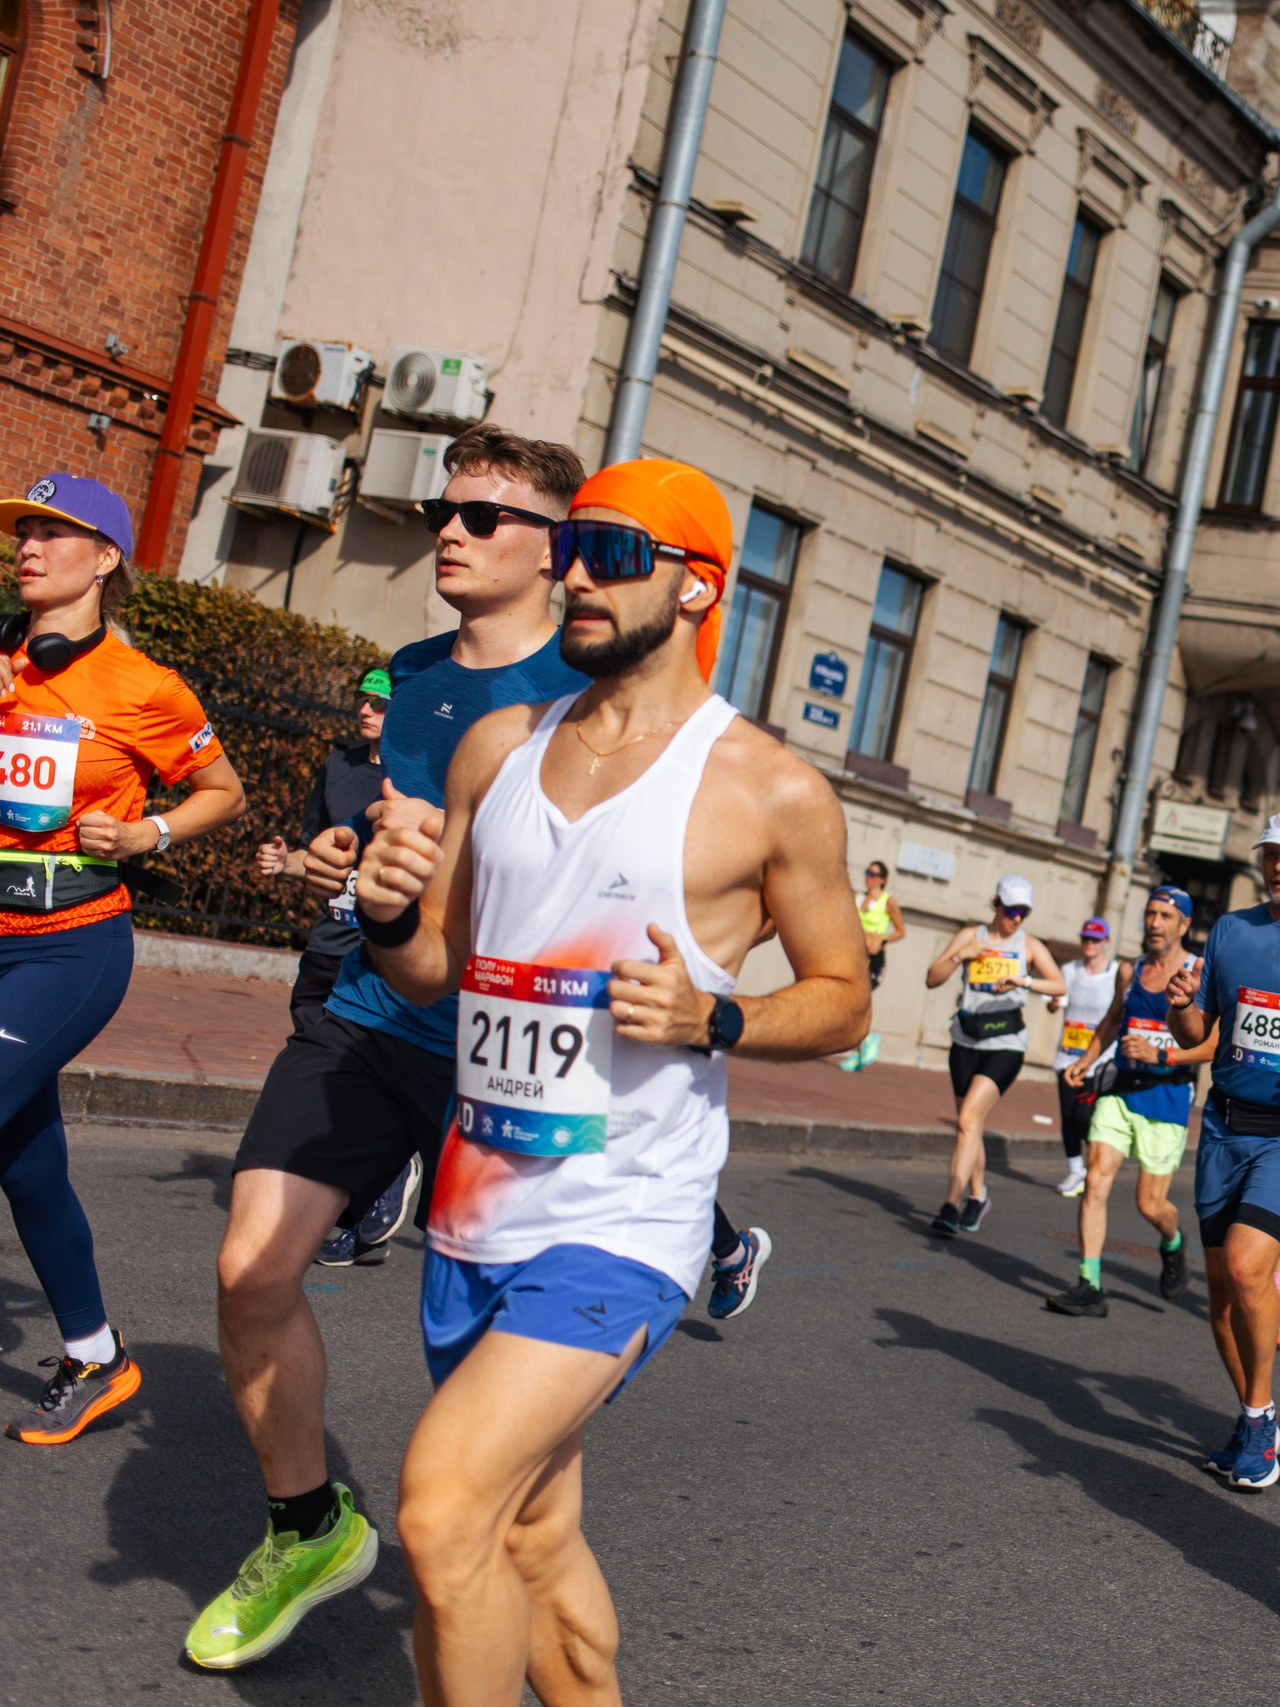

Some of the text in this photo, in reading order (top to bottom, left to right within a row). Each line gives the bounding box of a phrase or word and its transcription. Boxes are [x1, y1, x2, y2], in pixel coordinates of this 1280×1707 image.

[22, 720, 63, 734] 21,1 КМ
[533, 976, 589, 997] 21,1 КМ
[470, 1010, 583, 1079] 2119
[1253, 1039, 1280, 1049] РОМАН
[487, 1076, 544, 1099] АНДРЕЙ
